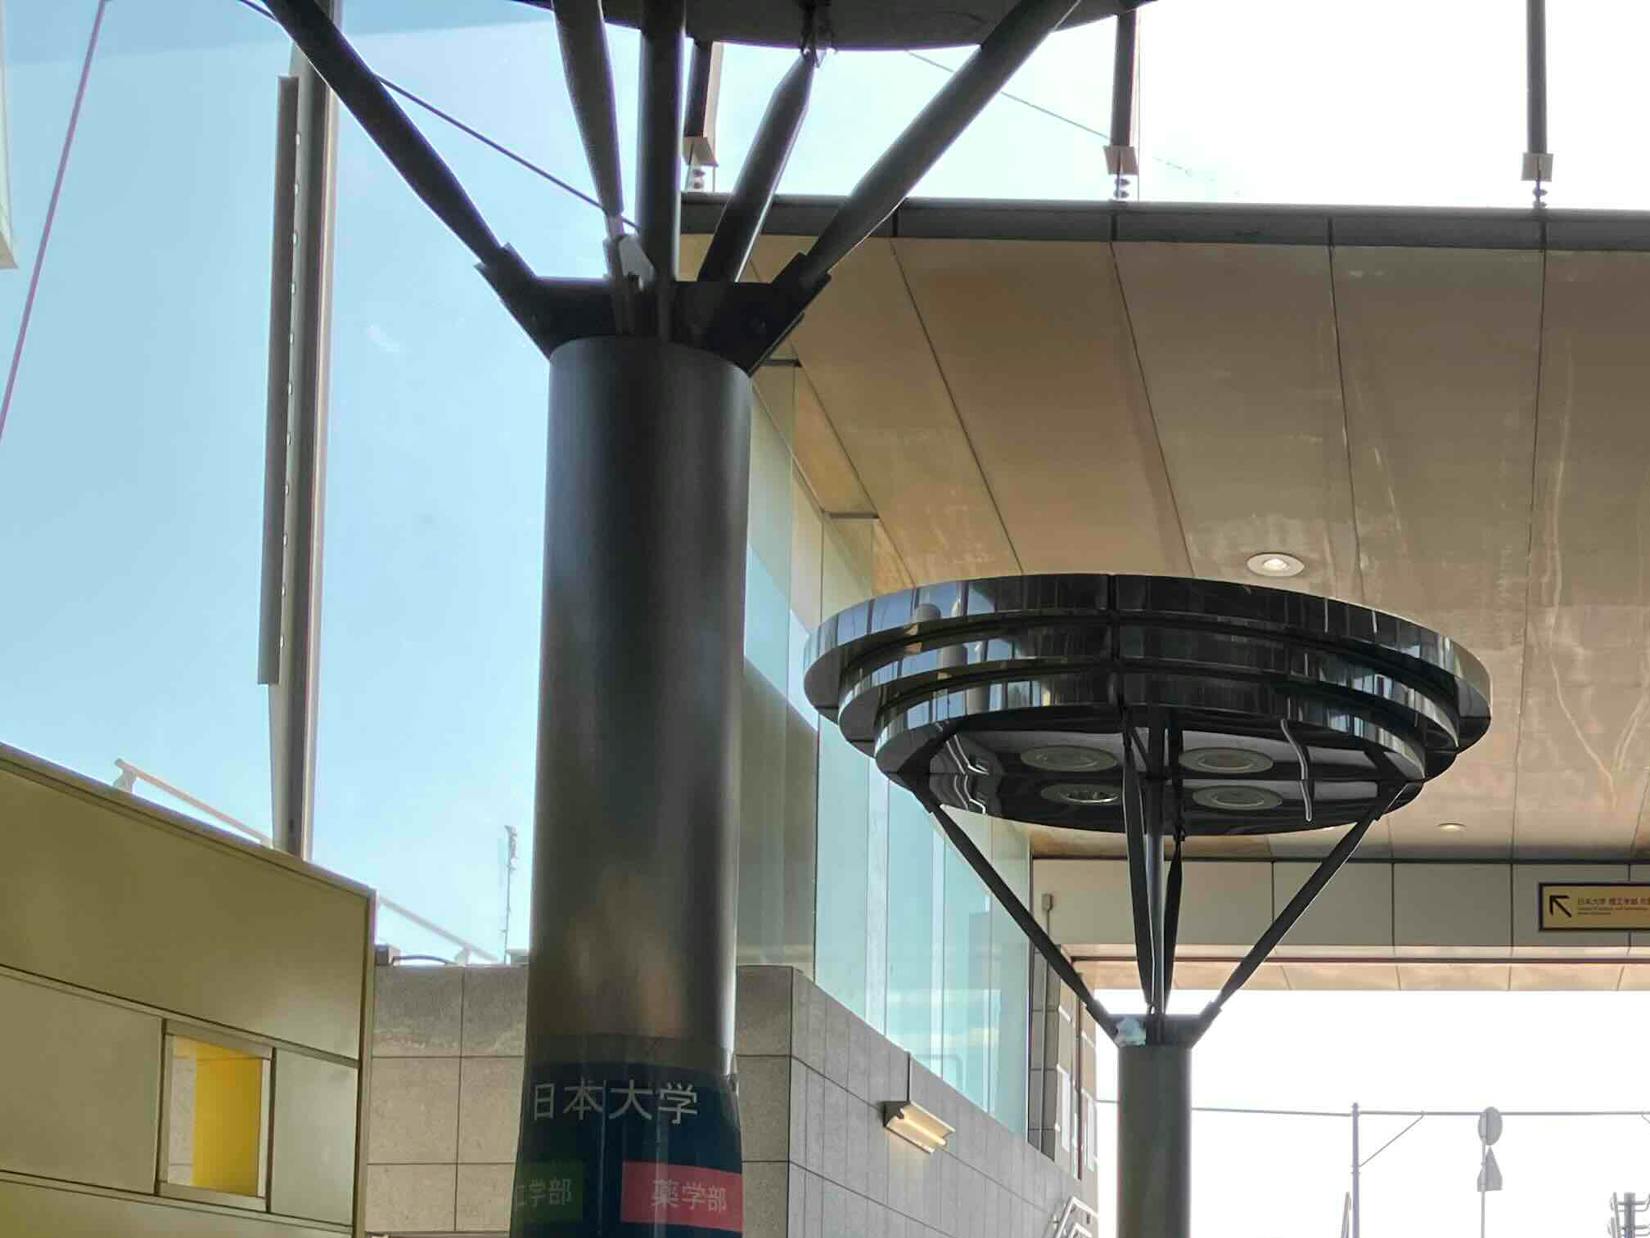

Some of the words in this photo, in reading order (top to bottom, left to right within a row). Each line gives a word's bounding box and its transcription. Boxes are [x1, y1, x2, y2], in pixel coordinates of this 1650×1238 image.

[533, 1079, 699, 1124] 日本大学
[651, 1179, 727, 1213] 薬学部
